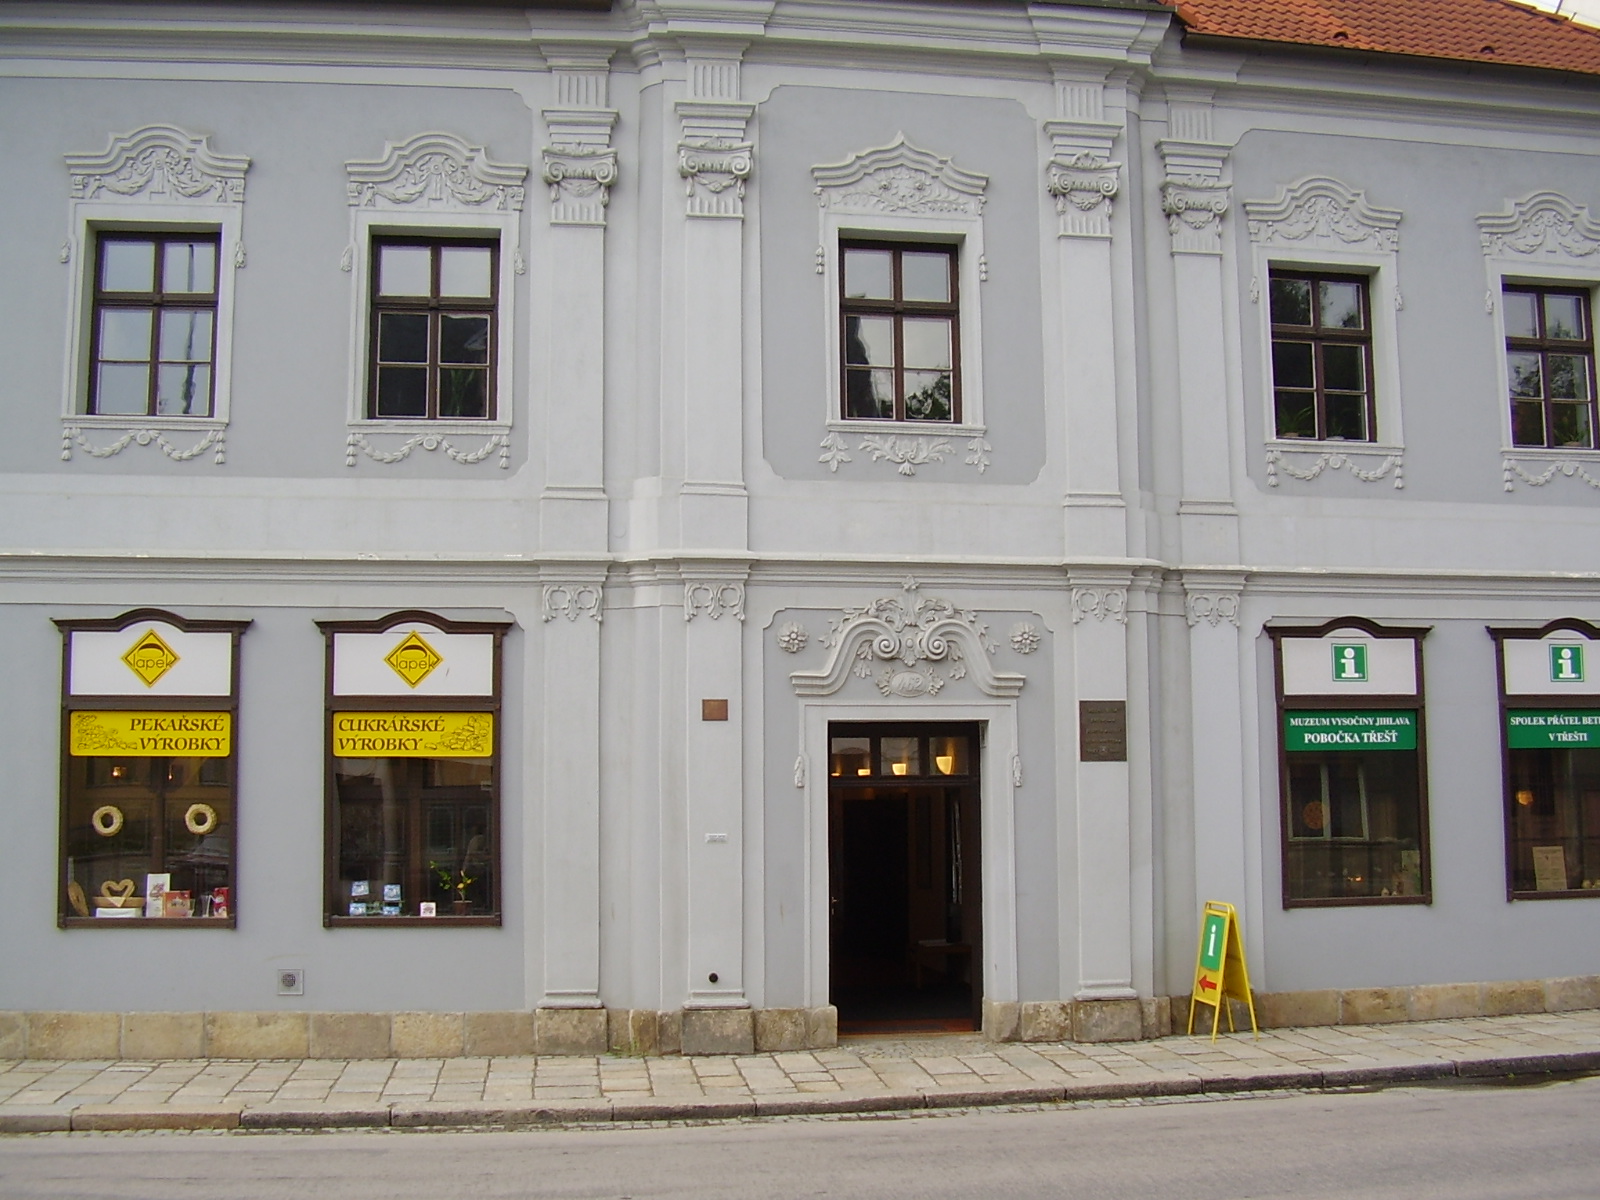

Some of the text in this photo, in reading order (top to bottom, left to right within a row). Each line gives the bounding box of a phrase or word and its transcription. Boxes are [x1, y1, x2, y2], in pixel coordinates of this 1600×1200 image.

[130, 714, 225, 732] PEKAŘSKÉ
[338, 715, 446, 732] CUKRÁŘSKÉ
[1290, 715, 1410, 726] MUZEUM VYSOČINY JIHLAVA
[1510, 716, 1546, 726] SPOLEK
[1547, 714, 1581, 725] PŘÁTEL
[140, 734, 226, 751] VÝROBKY
[338, 735, 424, 751] VÝROBKY
[1304, 730, 1398, 743] POBOČKA TŘEŠŤ
[1548, 731, 1588, 742] V TŘEŠTI
